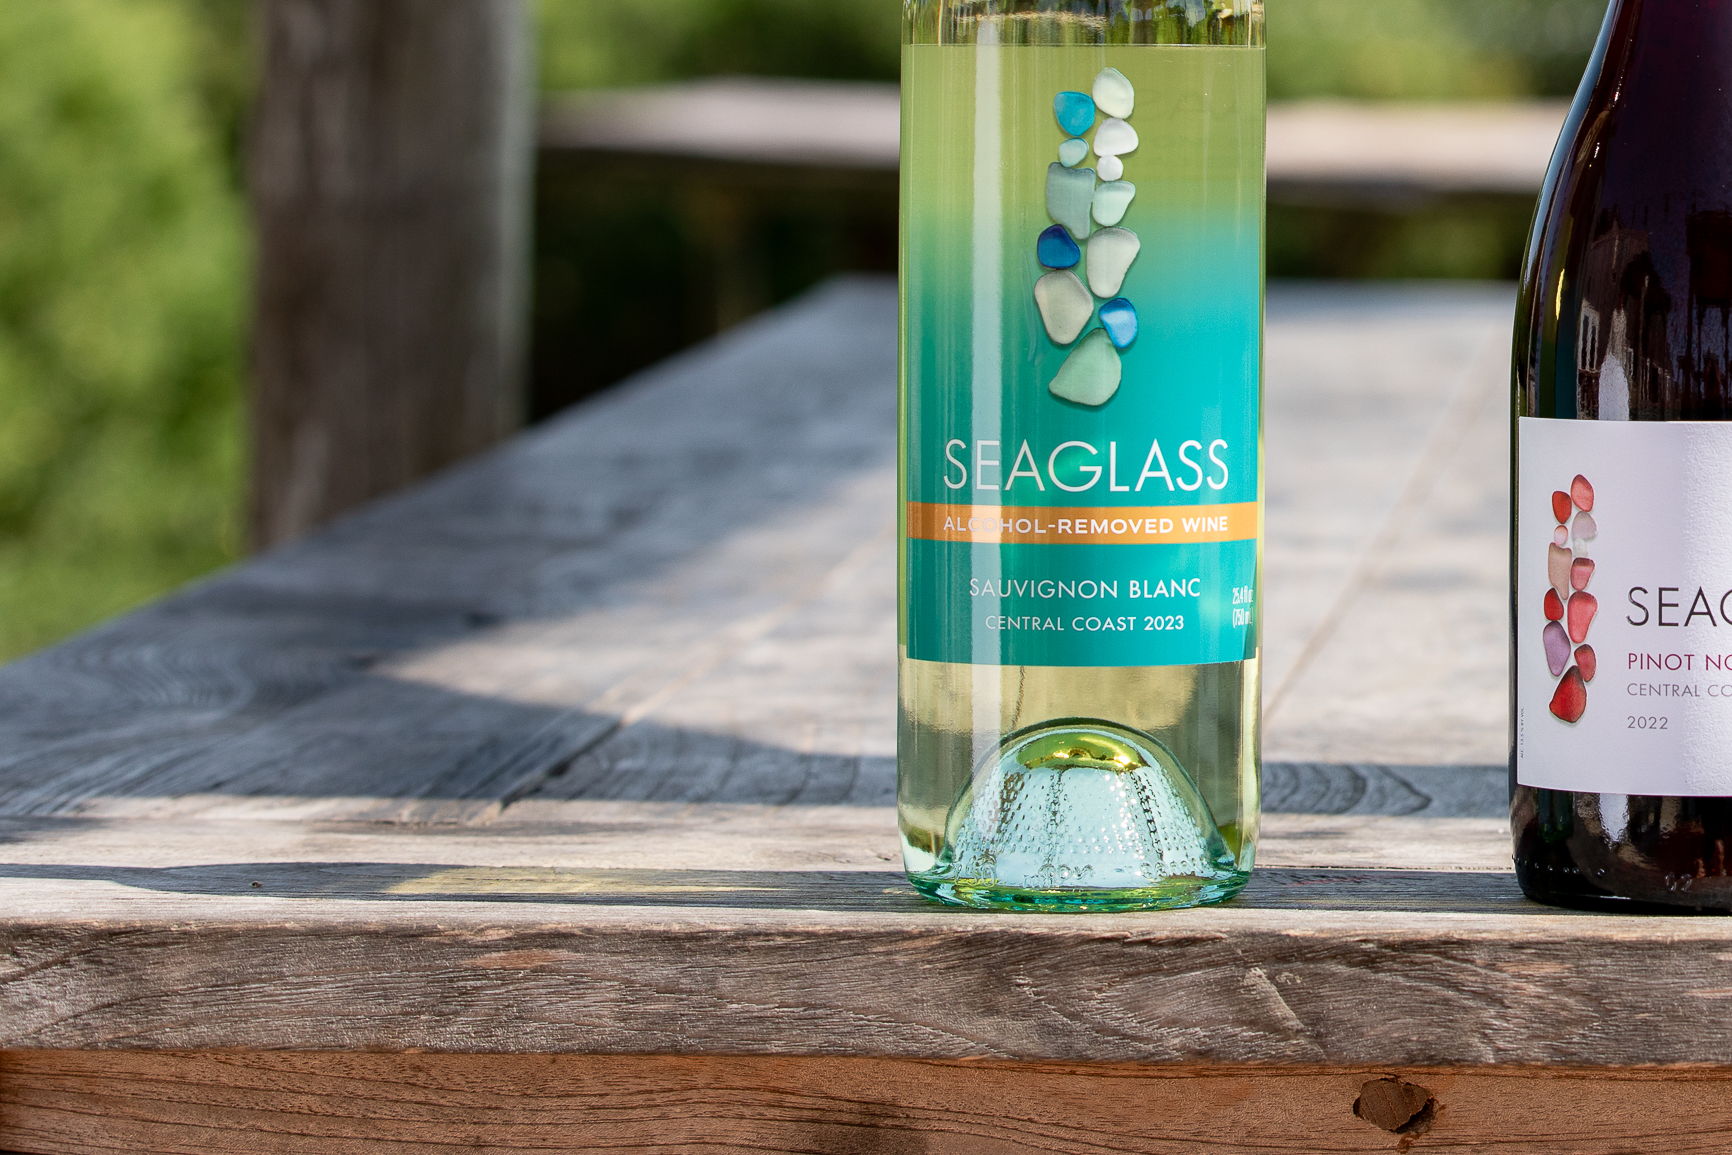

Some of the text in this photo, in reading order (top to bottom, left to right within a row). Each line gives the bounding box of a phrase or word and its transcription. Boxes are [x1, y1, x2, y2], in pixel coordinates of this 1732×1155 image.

[943, 437, 1230, 493] SEAGLASS
[942, 515, 1229, 535] ALCOHOL-REMOVED WINE
[969, 577, 1202, 599] SAUVIGNON BLANC
[985, 615, 1186, 632] CENTRAL COAST 2023
[1627, 652, 1696, 672] PINOT
[1626, 683, 1701, 698] CENTRAL
[1626, 715, 1669, 731] 2022
